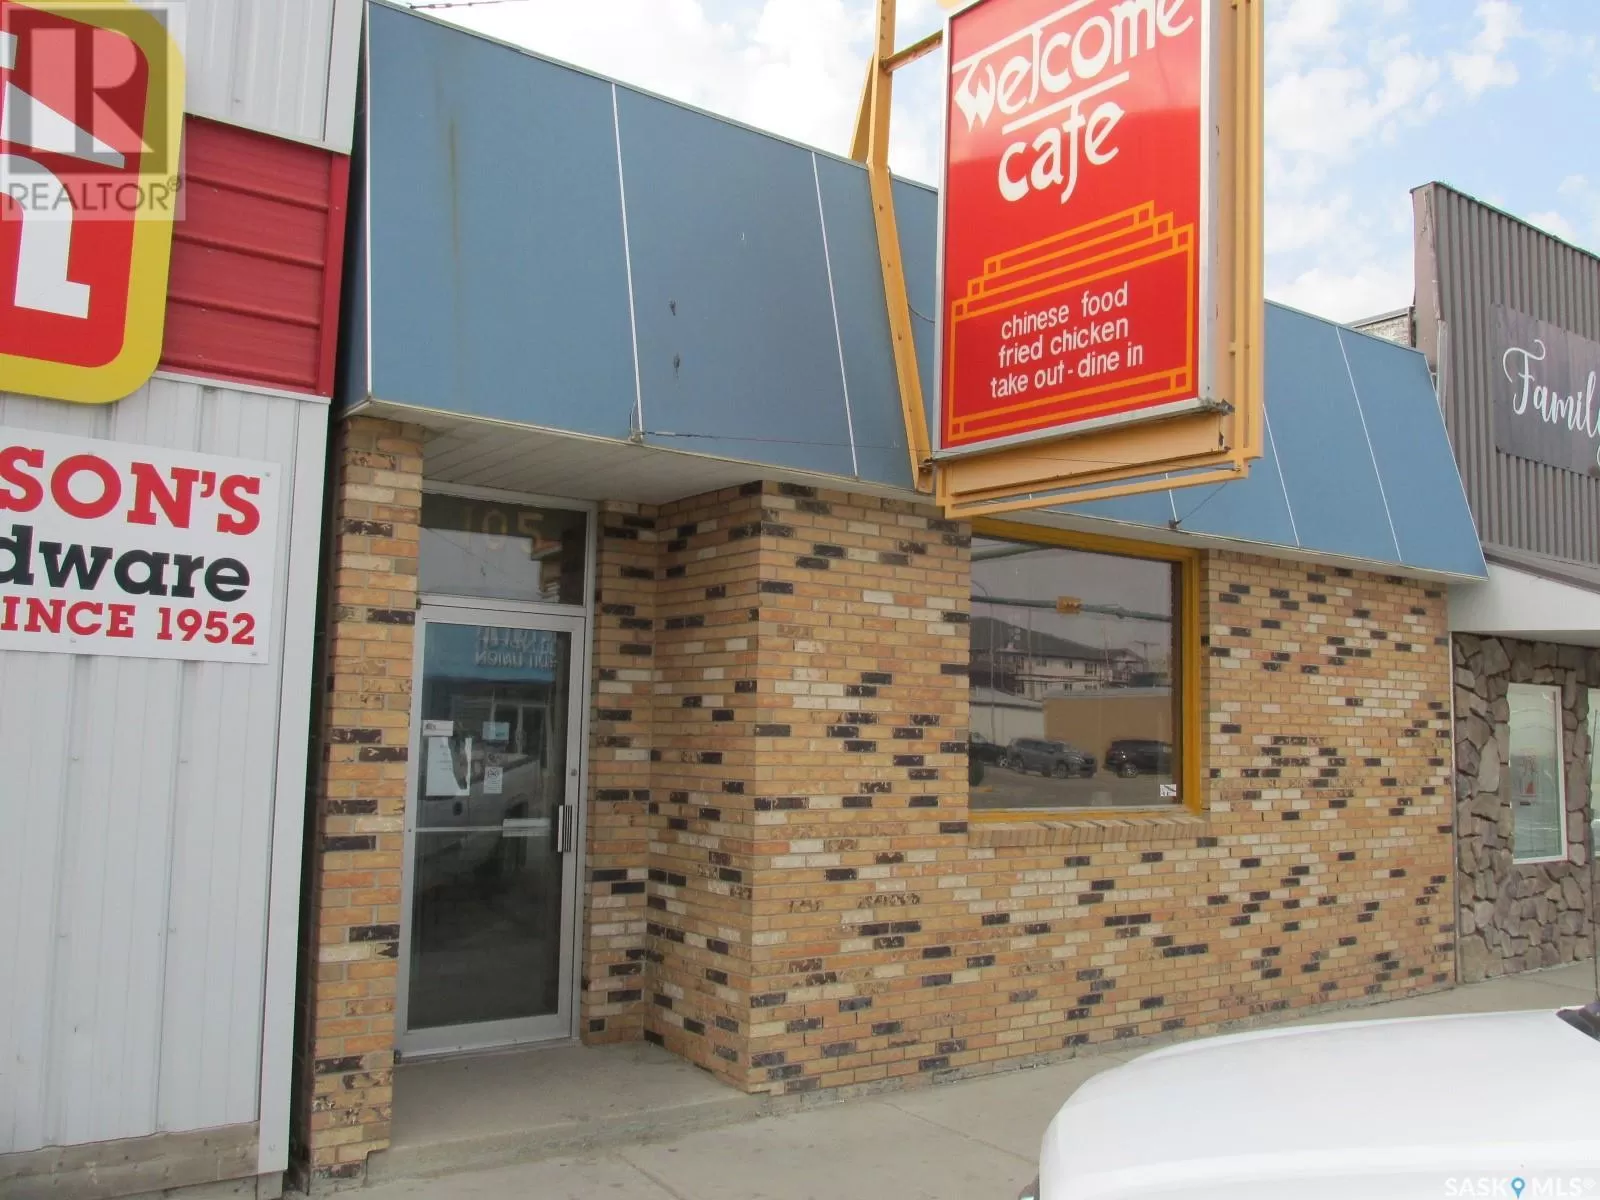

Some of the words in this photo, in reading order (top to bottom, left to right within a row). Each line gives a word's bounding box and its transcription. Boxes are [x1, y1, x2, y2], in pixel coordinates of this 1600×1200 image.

[998, 100, 1125, 204] cafe
[998, 335, 1044, 368] fried
[1050, 317, 1129, 355] chicken
[1001, 304, 1070, 340] chinese
[1081, 281, 1129, 318] food
[990, 374, 1029, 398] take
[1126, 342, 1143, 367] in
[1503, 339, 1600, 438] Famil
[0, 446, 261, 536] SON'S
[0, 524, 251, 602] dware
[0, 596, 136, 639] INCE
[157, 607, 256, 645] 1952
